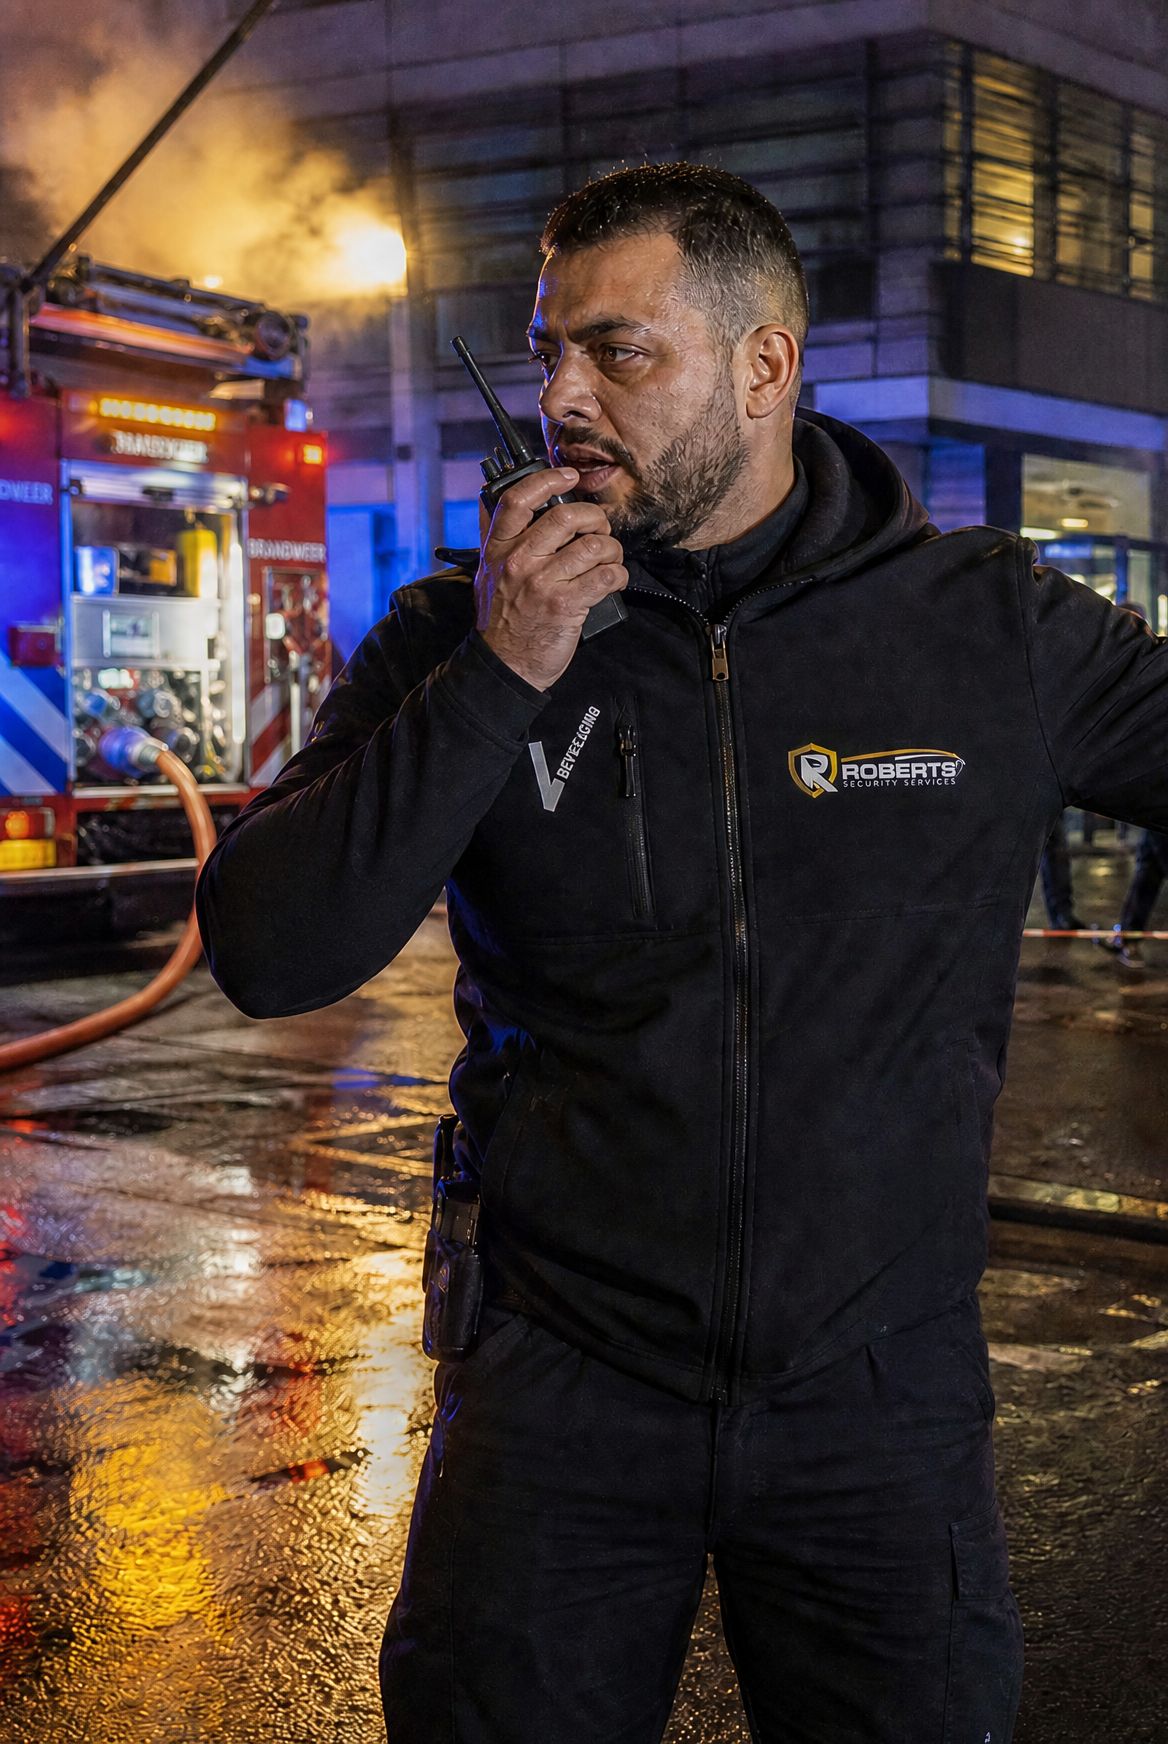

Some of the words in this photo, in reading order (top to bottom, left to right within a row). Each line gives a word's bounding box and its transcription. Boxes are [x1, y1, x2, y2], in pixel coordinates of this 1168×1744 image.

[841, 761, 957, 781] ROBERTS
[843, 779, 898, 788] SECURITY
[904, 778, 956, 787] SERVICES
